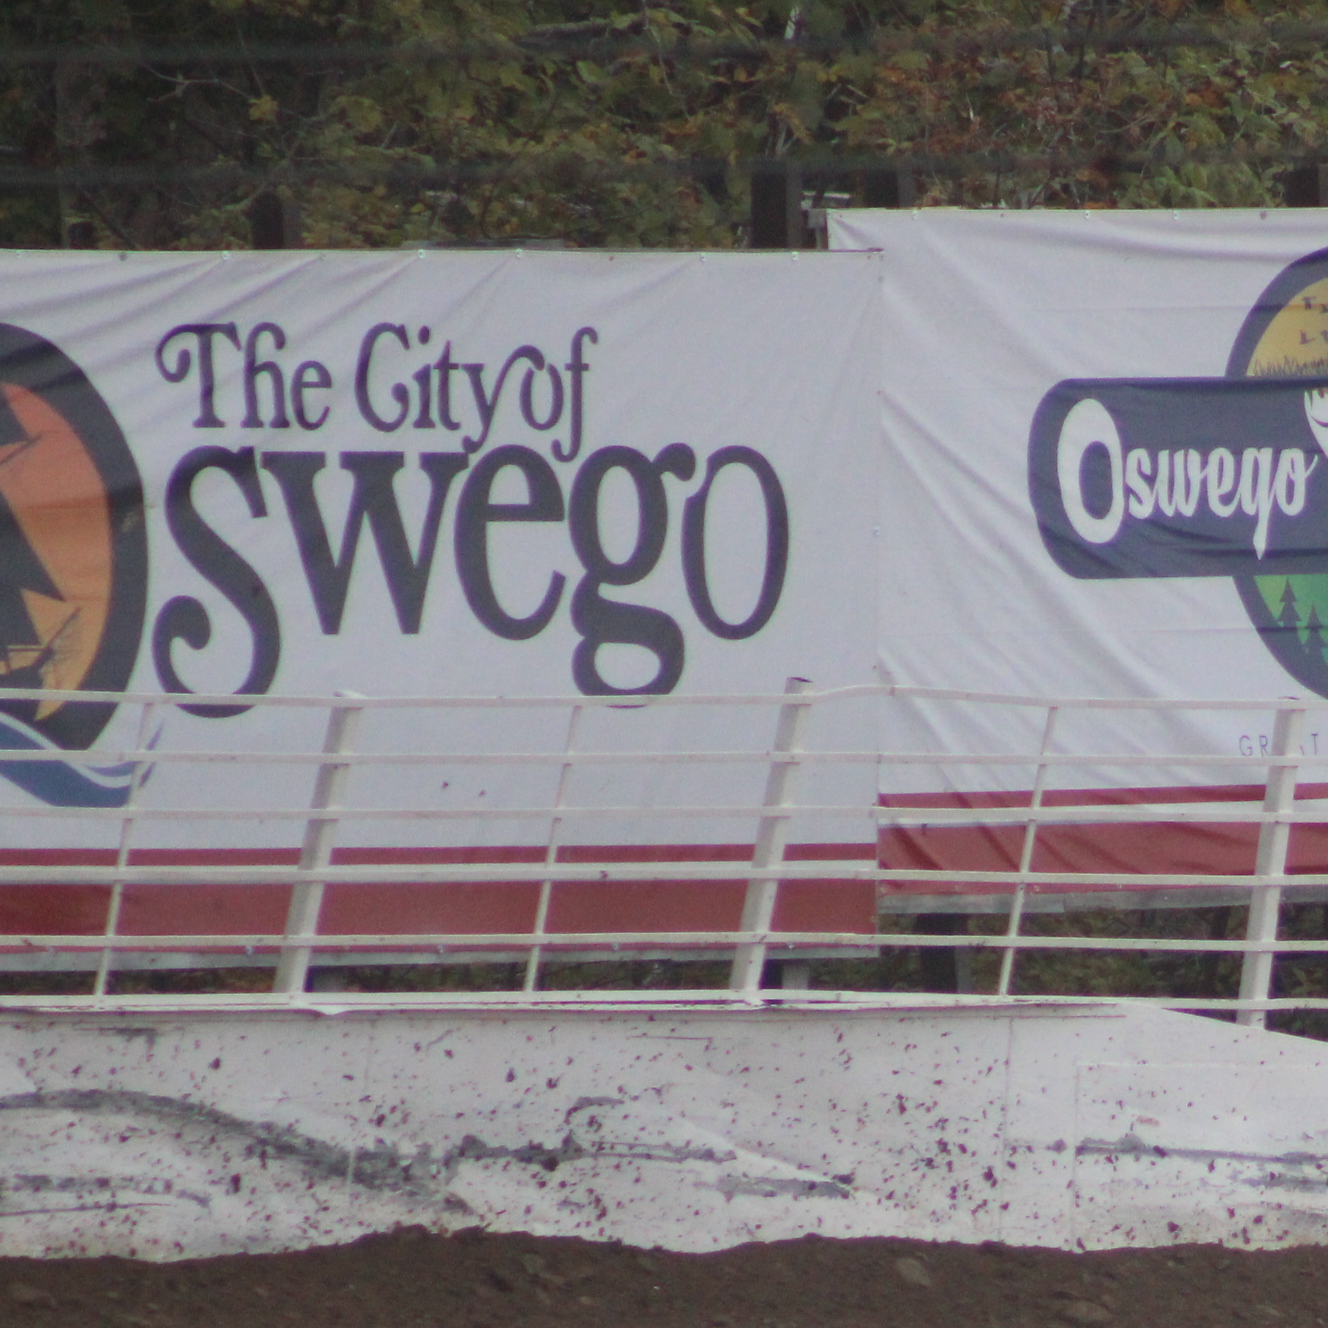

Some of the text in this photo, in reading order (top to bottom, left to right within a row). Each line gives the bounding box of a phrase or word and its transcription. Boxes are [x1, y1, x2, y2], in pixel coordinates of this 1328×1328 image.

[156, 322, 598, 462] The City of
[1057, 398, 1318, 560] Oswego
[1239, 732, 1318, 757] GRT
